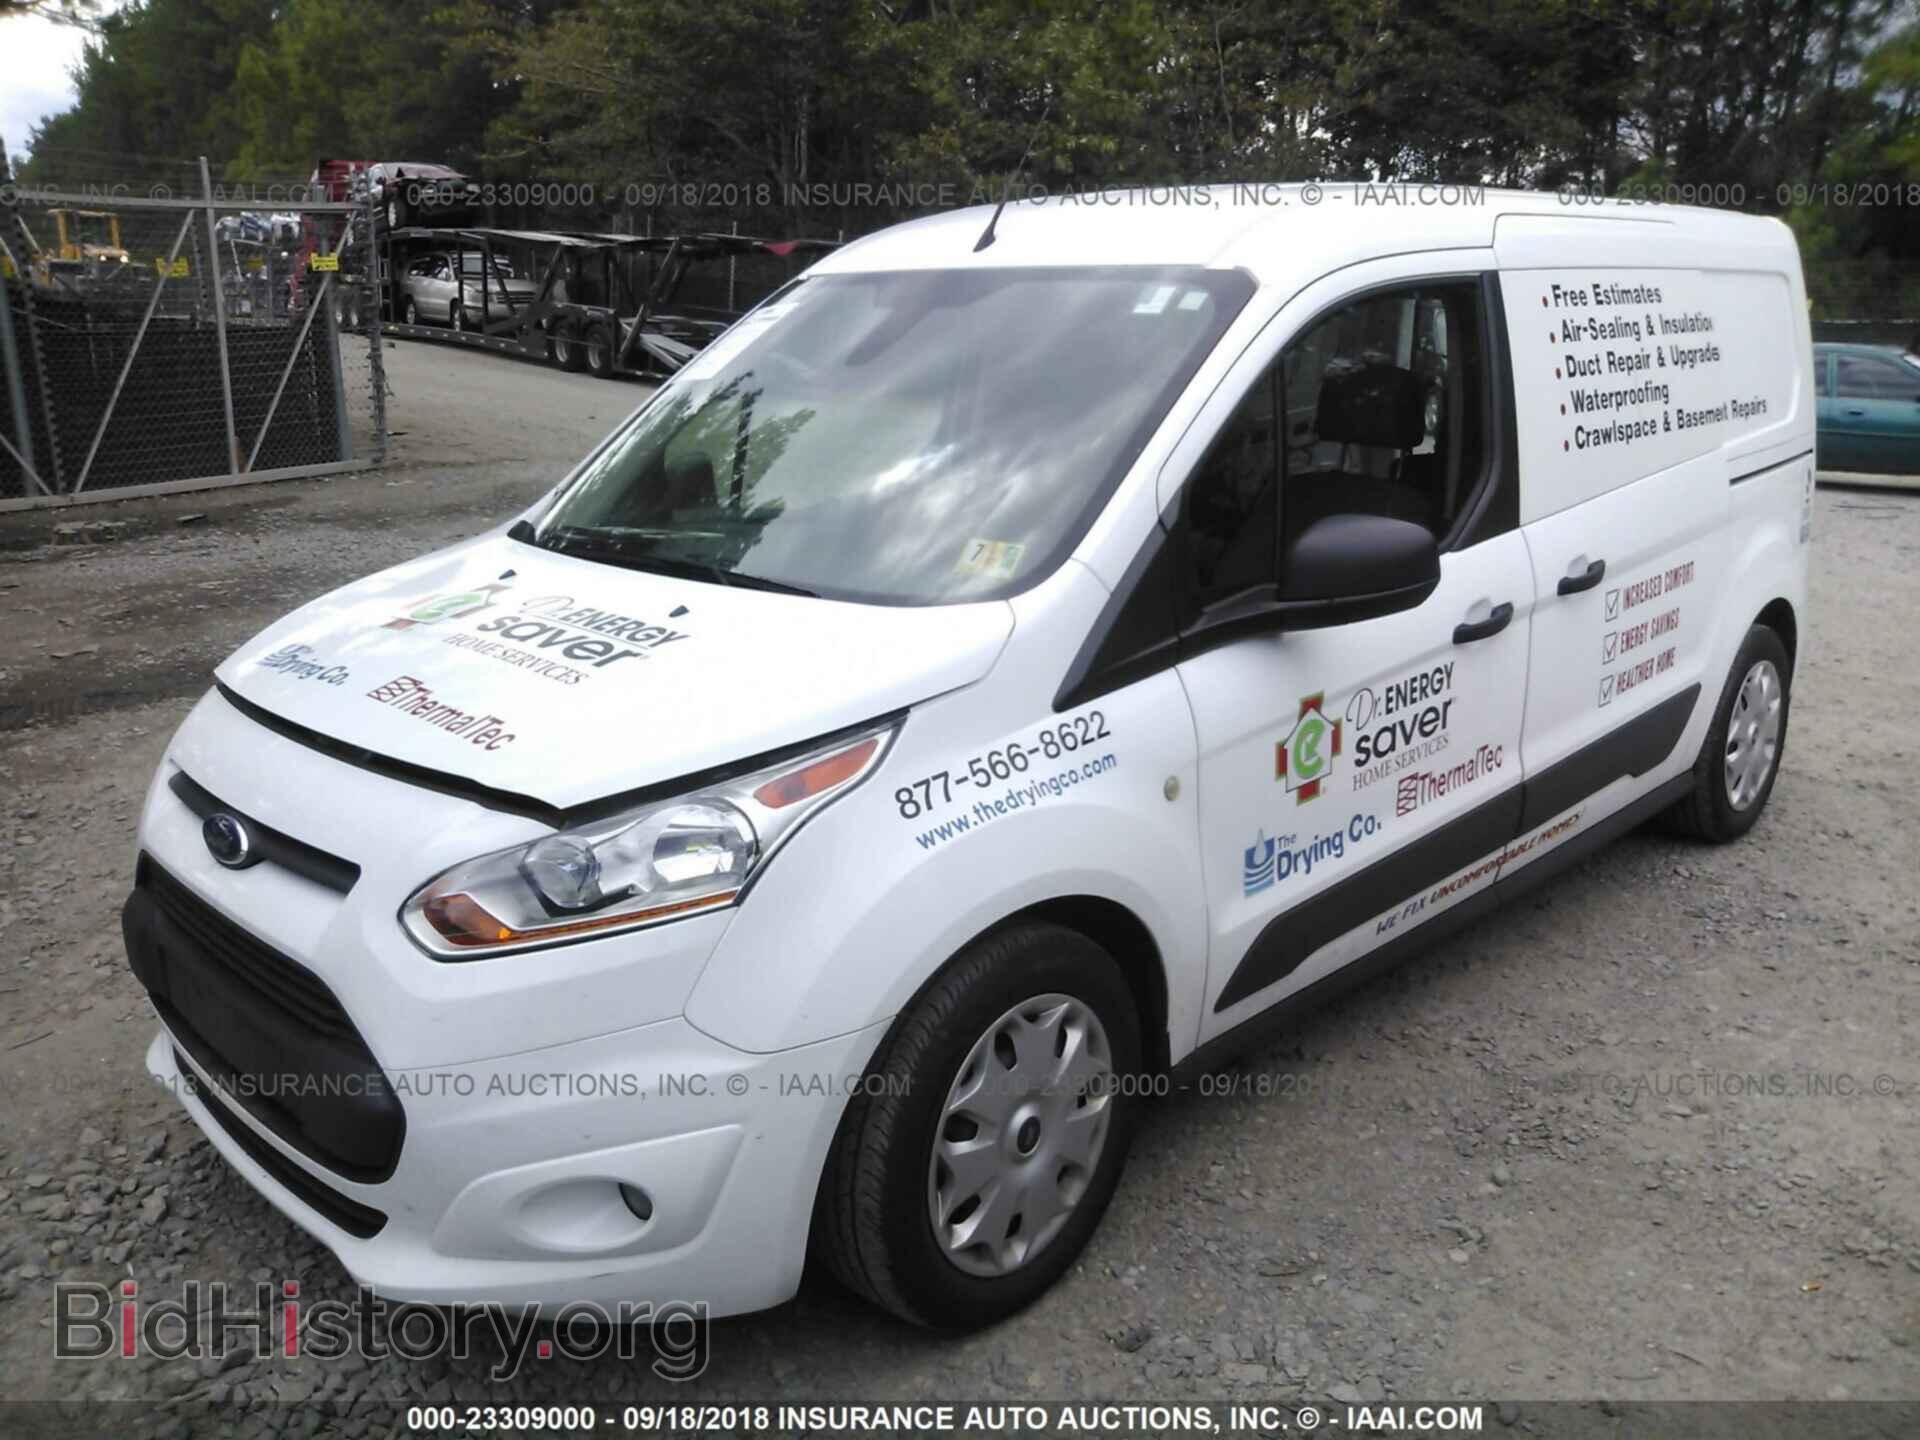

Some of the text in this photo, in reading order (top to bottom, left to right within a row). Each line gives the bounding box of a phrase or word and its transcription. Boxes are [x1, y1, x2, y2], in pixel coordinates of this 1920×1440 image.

[1551, 282, 1663, 308] Free Estimates
[1562, 315, 1641, 343] Air-Sealing
[1646, 313, 1655, 337] &
[1565, 353, 1603, 379] Duct
[1606, 348, 1651, 376] Repair
[1657, 346, 1666, 368] &
[1570, 380, 1670, 414] Waterproofing
[1574, 418, 1657, 450] Crawlspace
[1663, 410, 1671, 432] &
[1731, 396, 1767, 420] Repairs
[1623, 560, 1695, 611] INCREASED COMFORT
[476, 615, 641, 668] saver
[560, 606, 691, 648] ENERGY
[1620, 606, 1680, 654] ENERGY SAVINGS
[443, 633, 590, 686] HOME SERVICES
[1616, 646, 1676, 695] HEALTHIER HOME
[389, 686, 517, 752] ThermalTec
[1345, 661, 1455, 732] Dr. ENERGY
[1353, 696, 1454, 769] saver
[894, 710, 1112, 820] 877-566-8622
[1352, 737, 1449, 792] HOME SERVICES
[1416, 744, 1504, 805] ThermalTec
[915, 752, 1118, 850] www.thedryingco.com
[1277, 833, 1297, 851] The
[1277, 813, 1382, 882] Drying Co.
